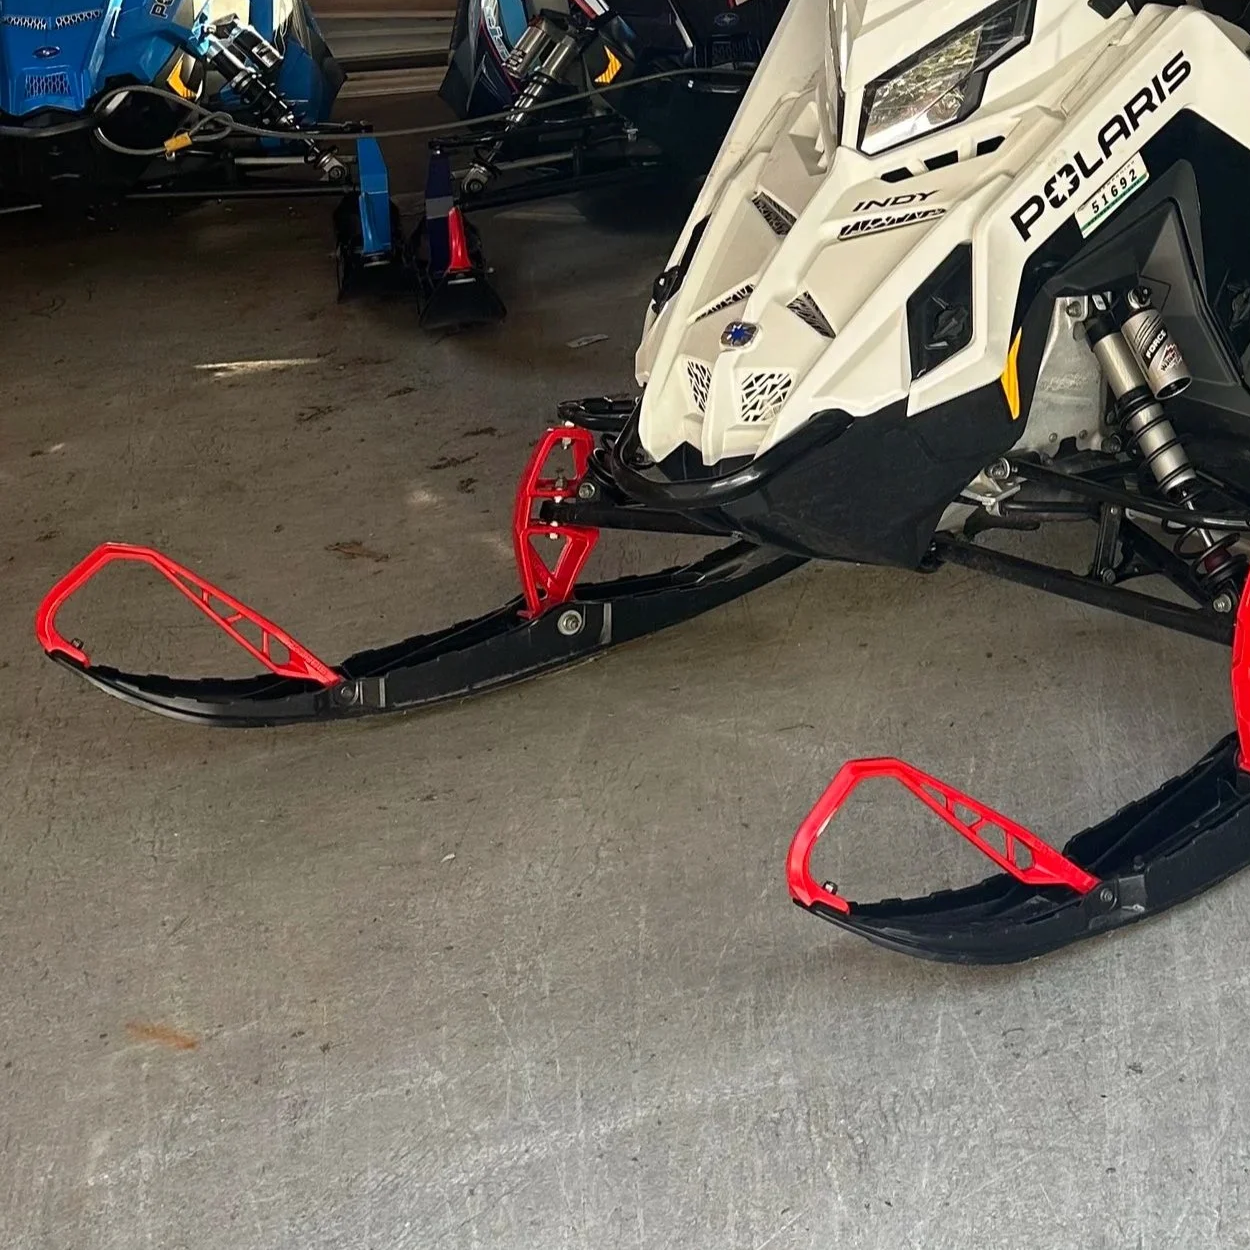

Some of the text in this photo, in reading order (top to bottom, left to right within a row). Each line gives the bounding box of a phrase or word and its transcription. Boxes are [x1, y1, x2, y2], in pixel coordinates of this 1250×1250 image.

[1010, 50, 1192, 243] POLARIS
[852, 189, 940, 212] INDY
[1091, 168, 1138, 214] 51692
